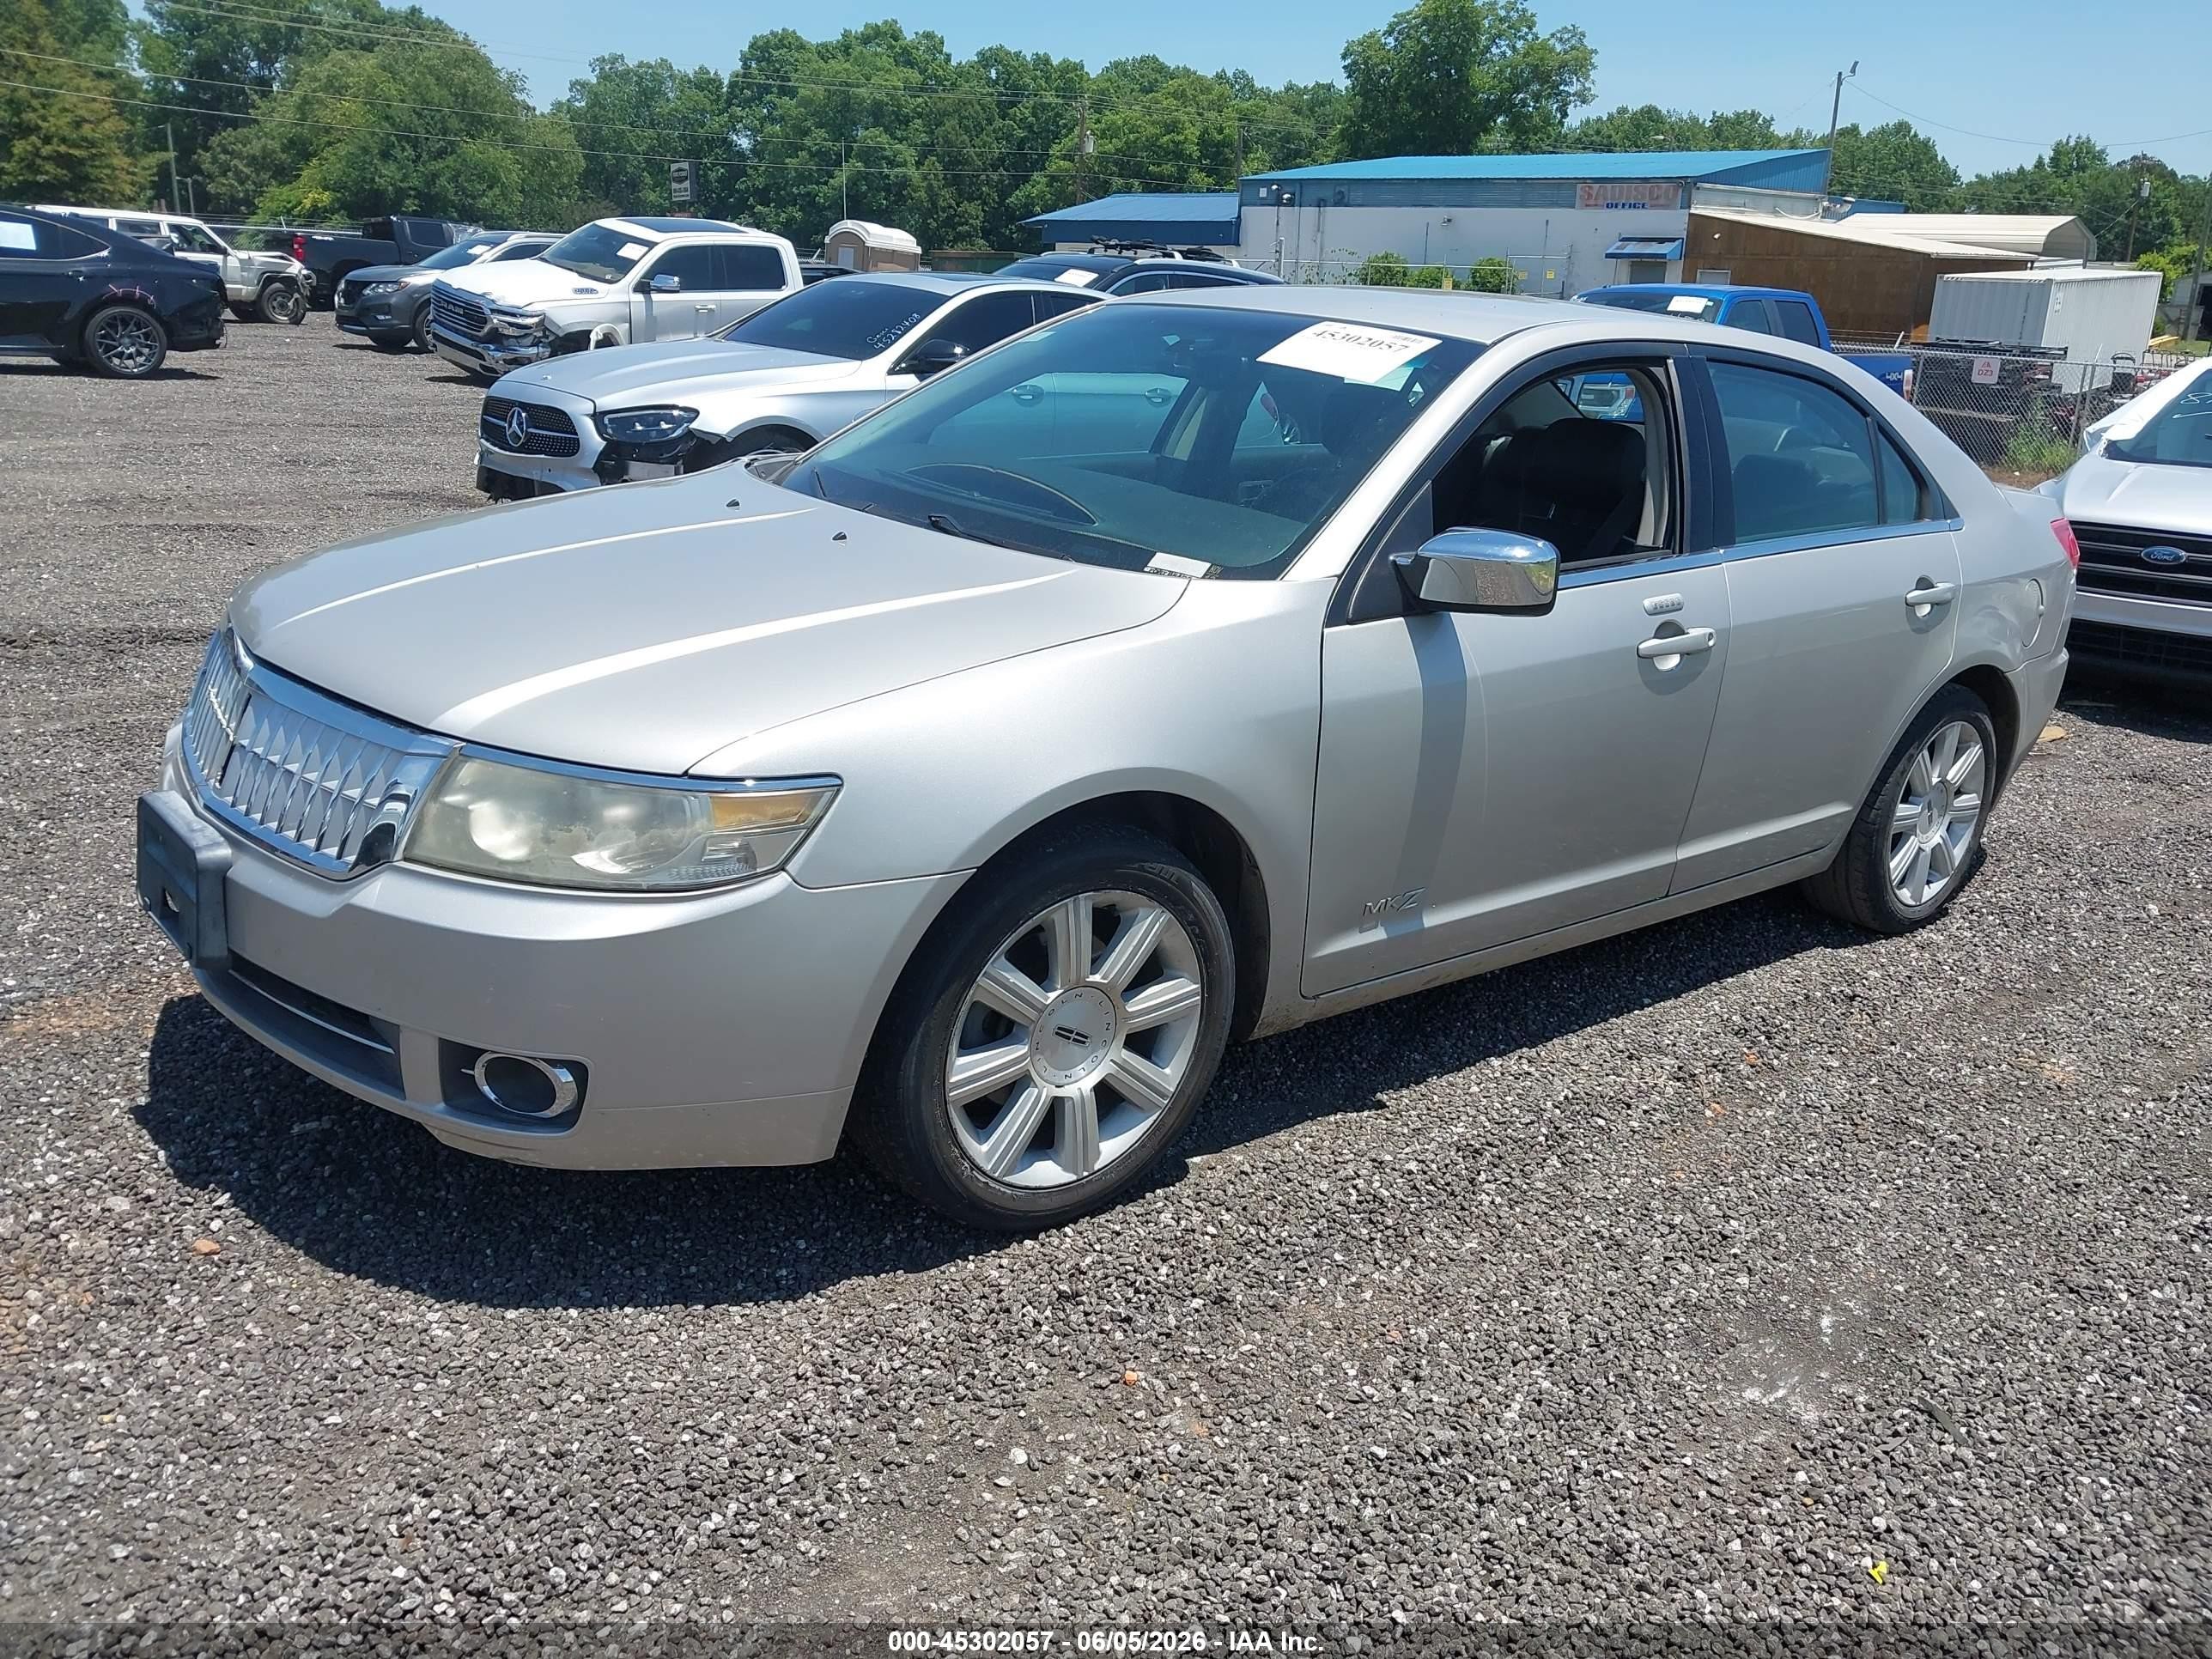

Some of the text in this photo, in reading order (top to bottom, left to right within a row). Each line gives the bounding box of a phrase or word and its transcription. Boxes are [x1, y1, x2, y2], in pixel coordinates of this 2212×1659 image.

[1580, 185, 1680, 201] SADISCO
[440, 301, 464, 315] RAM
[1314, 330, 1409, 353] 45302057
[2150, 550, 2177, 562] Ford
[1362, 886, 1426, 917] MKZ
